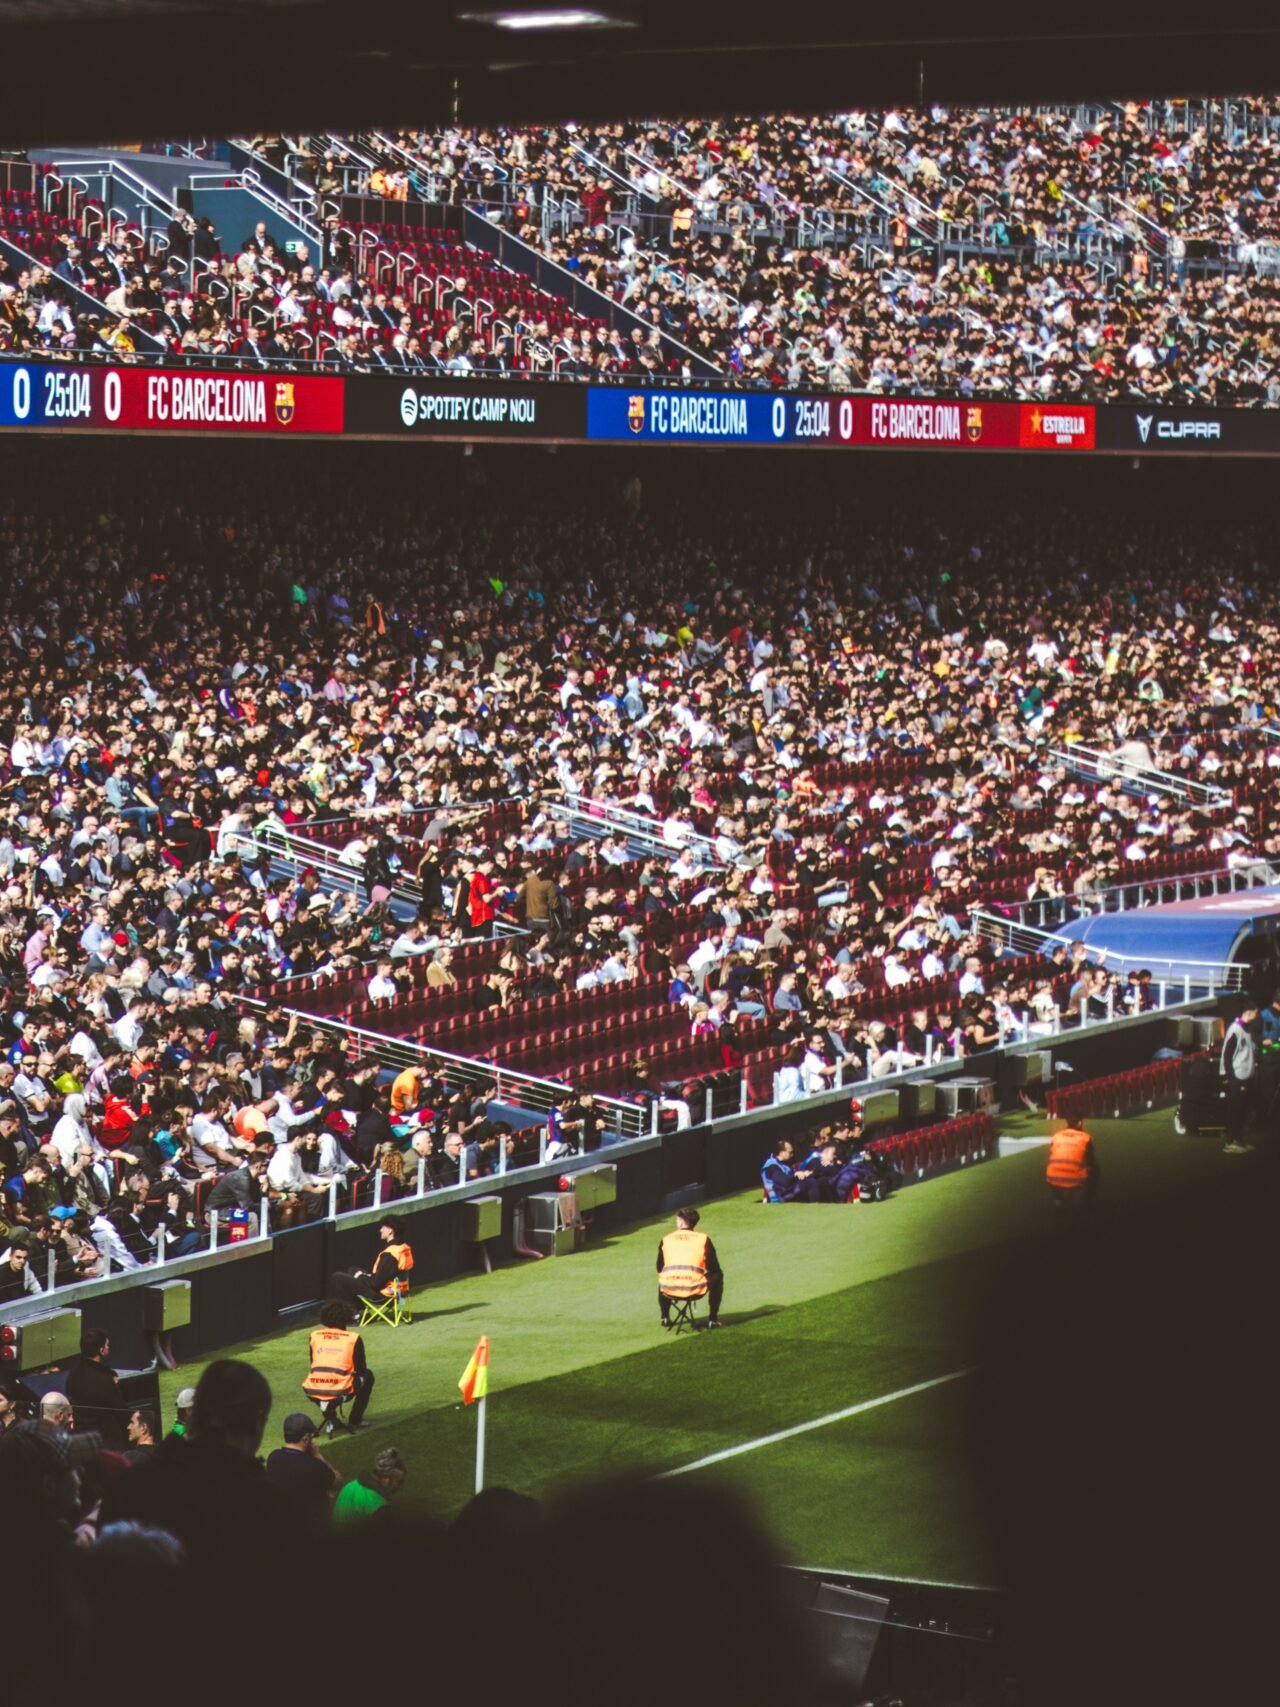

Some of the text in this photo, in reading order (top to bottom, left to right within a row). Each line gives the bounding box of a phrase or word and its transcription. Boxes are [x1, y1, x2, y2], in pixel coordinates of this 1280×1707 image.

[13, 368, 31, 419] 0
[44, 371, 91, 418] 25:04
[104, 371, 122, 421] 0
[147, 376, 267, 423] FC BARCELONA
[419, 395, 535, 423] SPOTIFY CAMP NOU
[651, 395, 748, 434] FC BARCELONA
[772, 397, 786, 438] 0
[795, 400, 831, 437] 25:04
[839, 400, 853, 440] 0
[871, 403, 961, 440] FC BARCELONA
[1042, 415, 1085, 435] ESTRELLA
[1157, 421, 1221, 439] CUPRA
